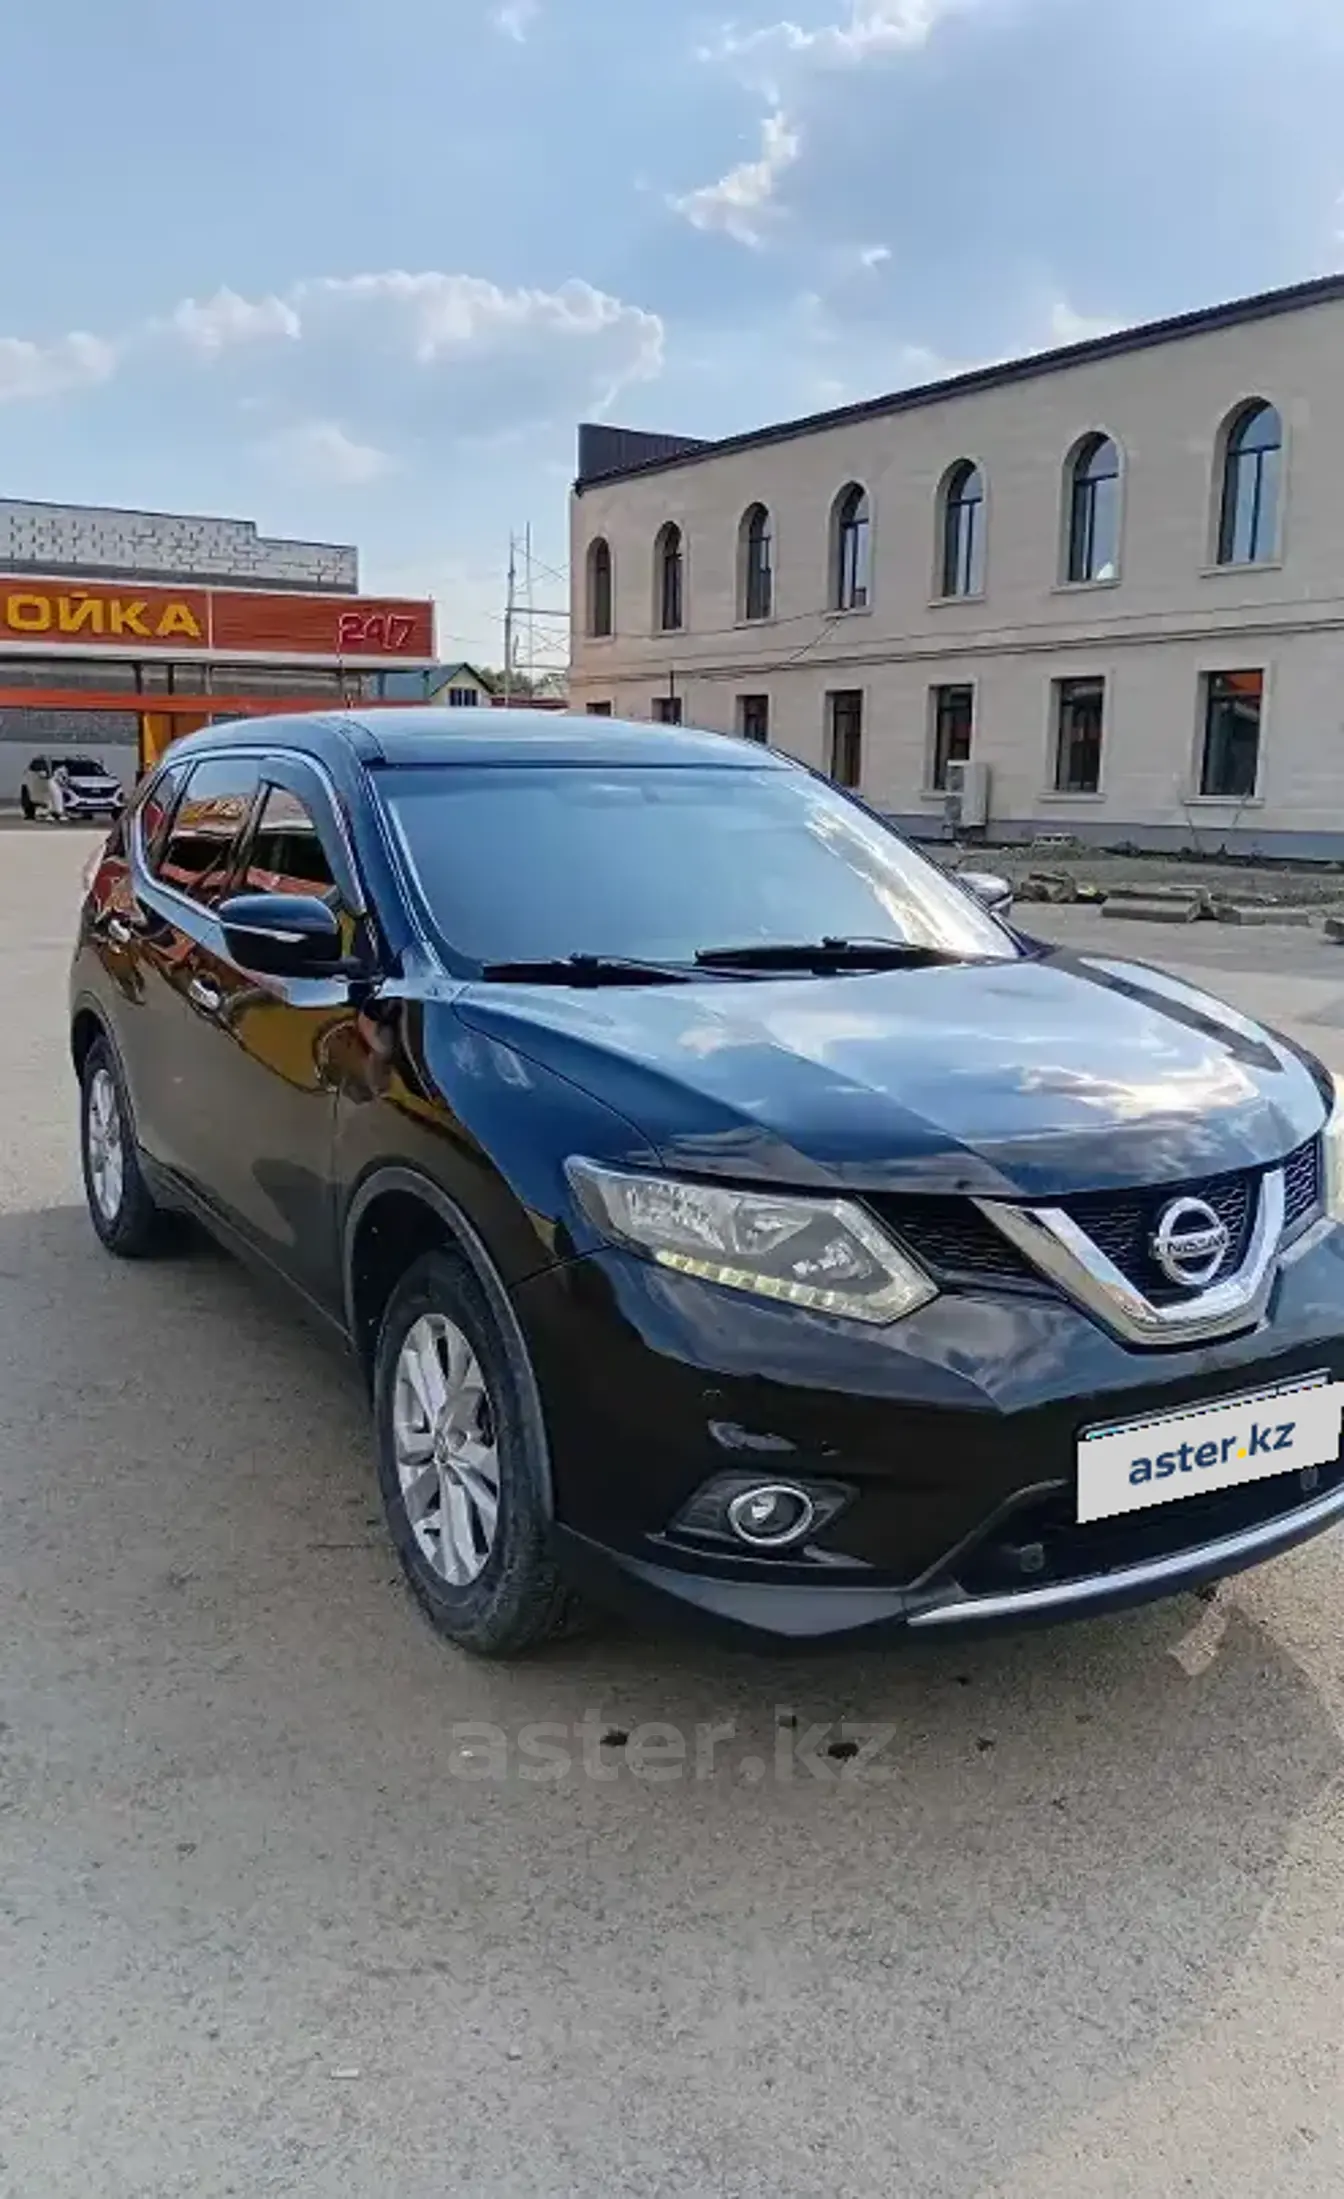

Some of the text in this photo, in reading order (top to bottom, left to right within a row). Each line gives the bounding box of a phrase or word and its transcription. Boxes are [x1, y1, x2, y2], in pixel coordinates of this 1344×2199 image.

[7, 591, 201, 637] ОЙКА
[338, 611, 418, 650] 24/7
[1166, 1230, 1226, 1254] NISSAN
